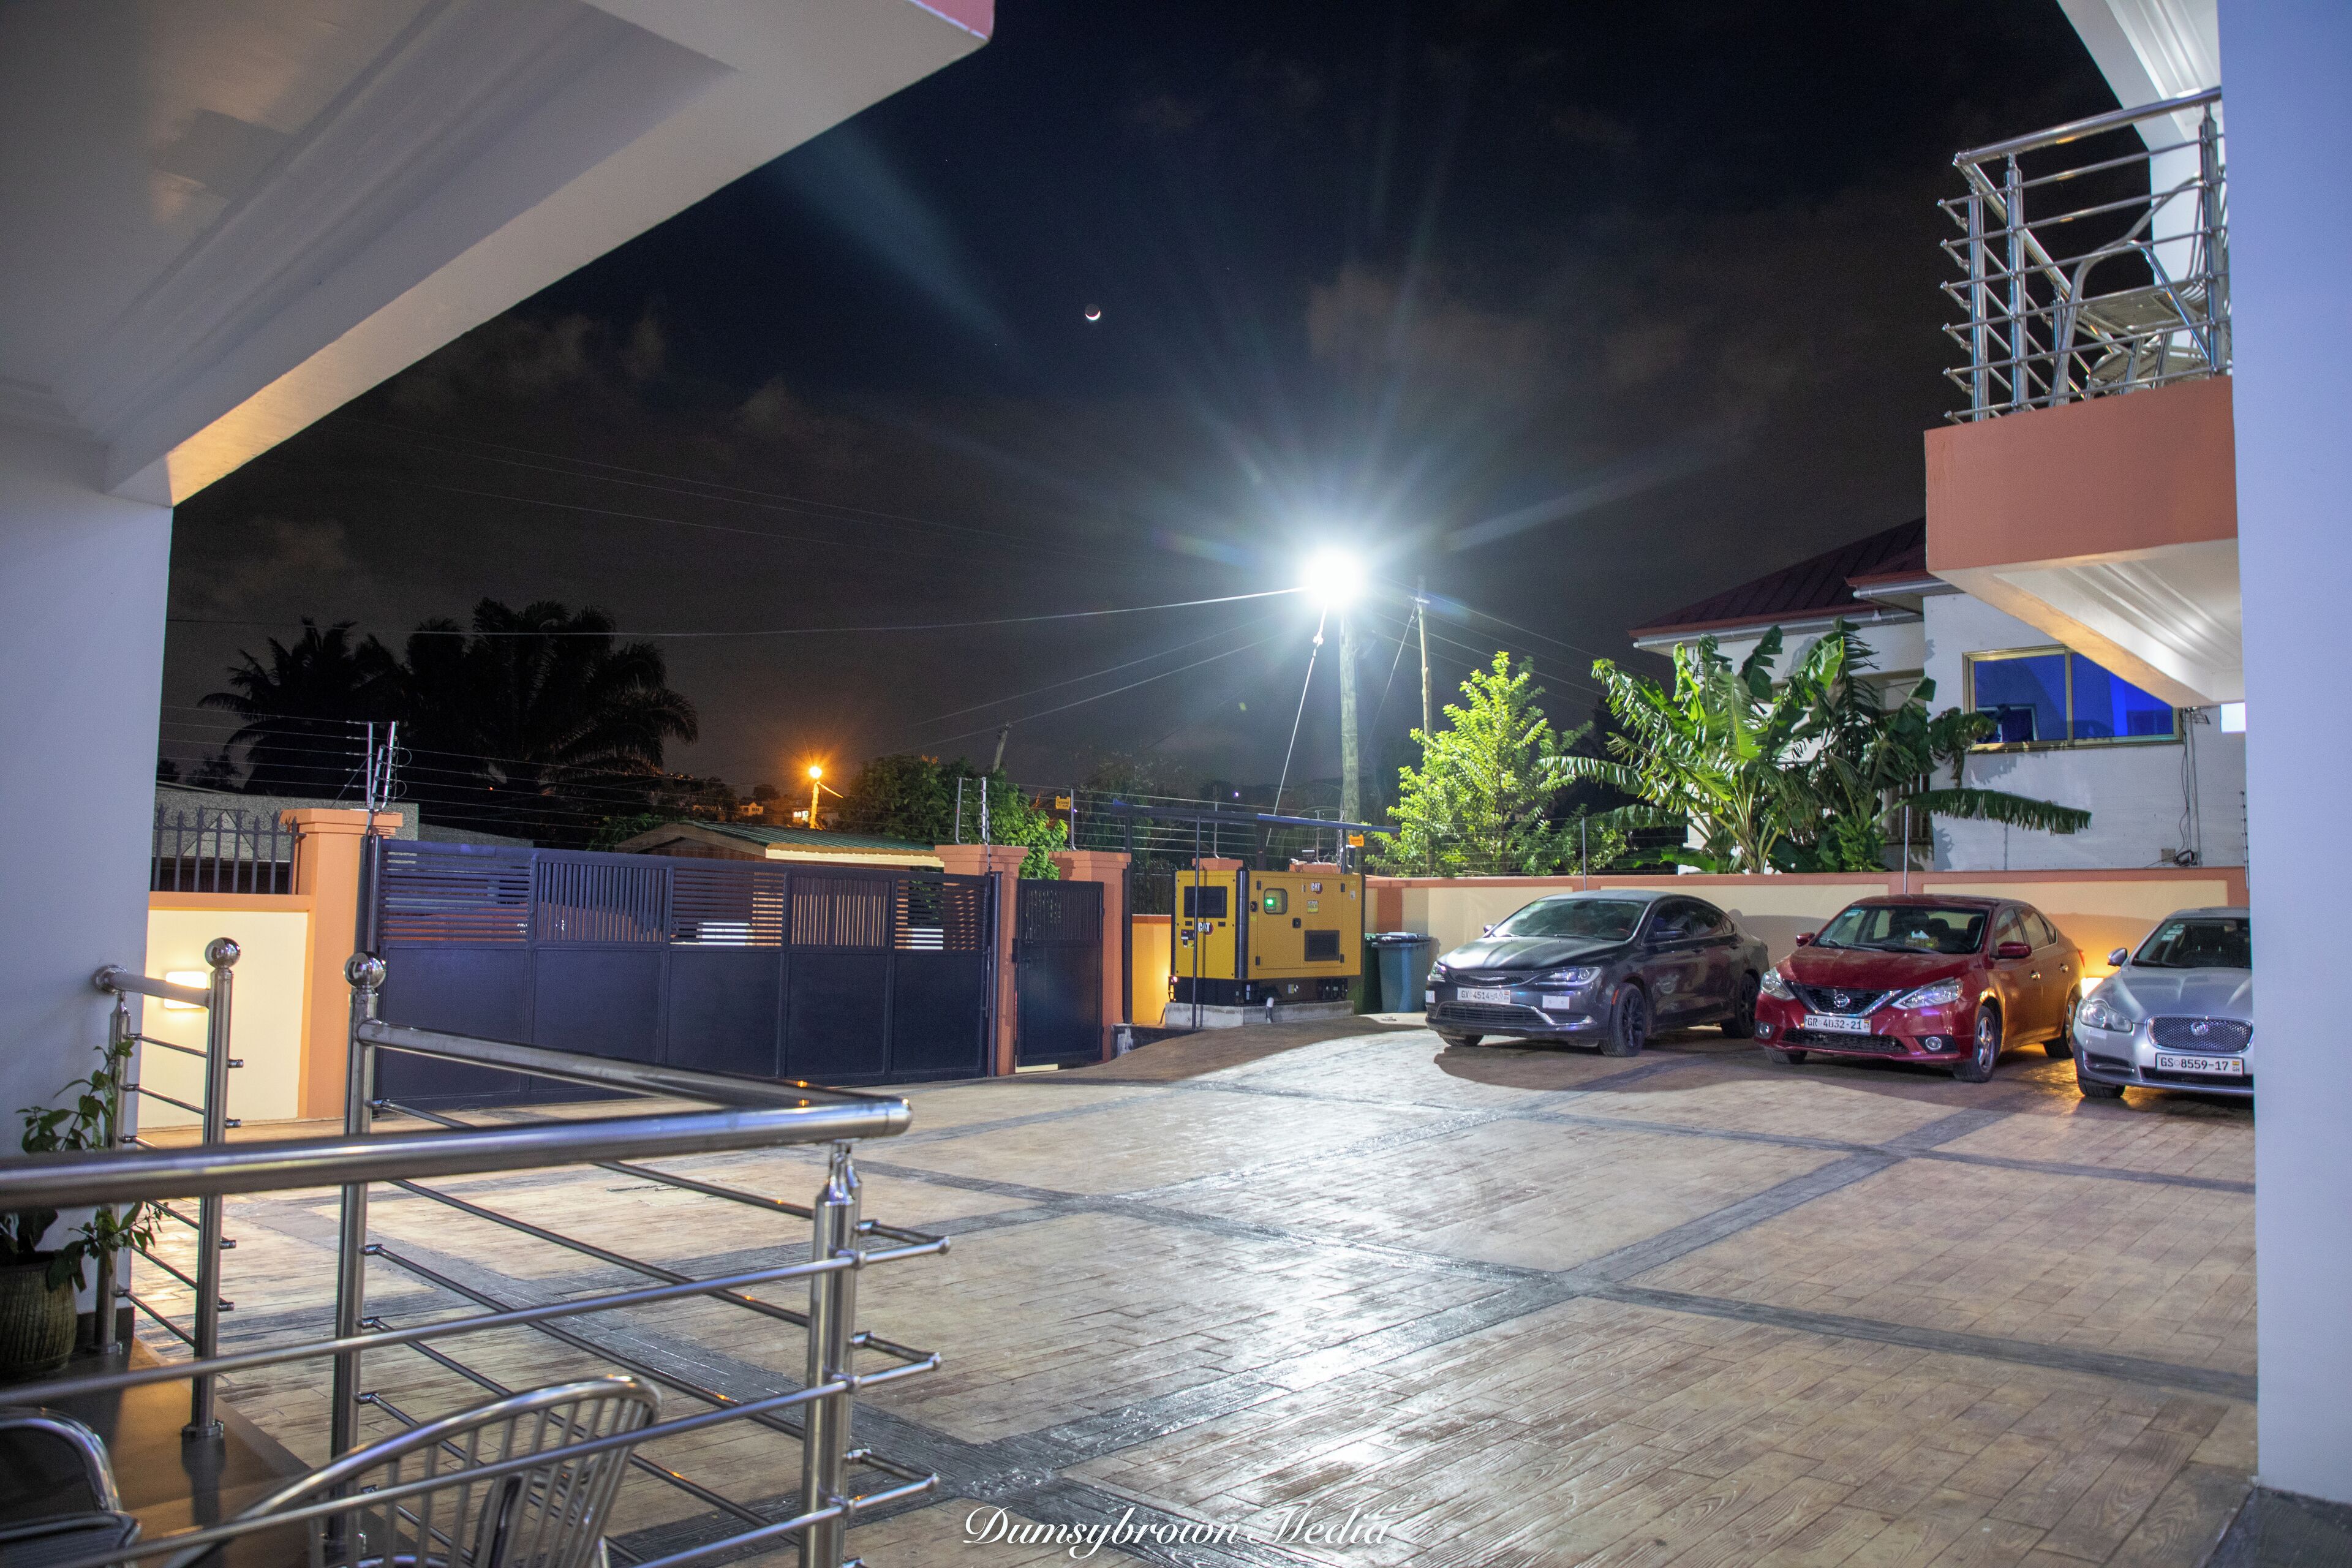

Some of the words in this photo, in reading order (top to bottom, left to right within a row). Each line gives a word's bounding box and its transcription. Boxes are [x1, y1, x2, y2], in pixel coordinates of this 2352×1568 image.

[1311, 883, 1321, 892] CAT
[1198, 922, 1210, 932] CAT
[1807, 1018, 1818, 1027] GR
[2160, 1057, 2173, 1067] GS
[2181, 1059, 2228, 1071] 8559-17
